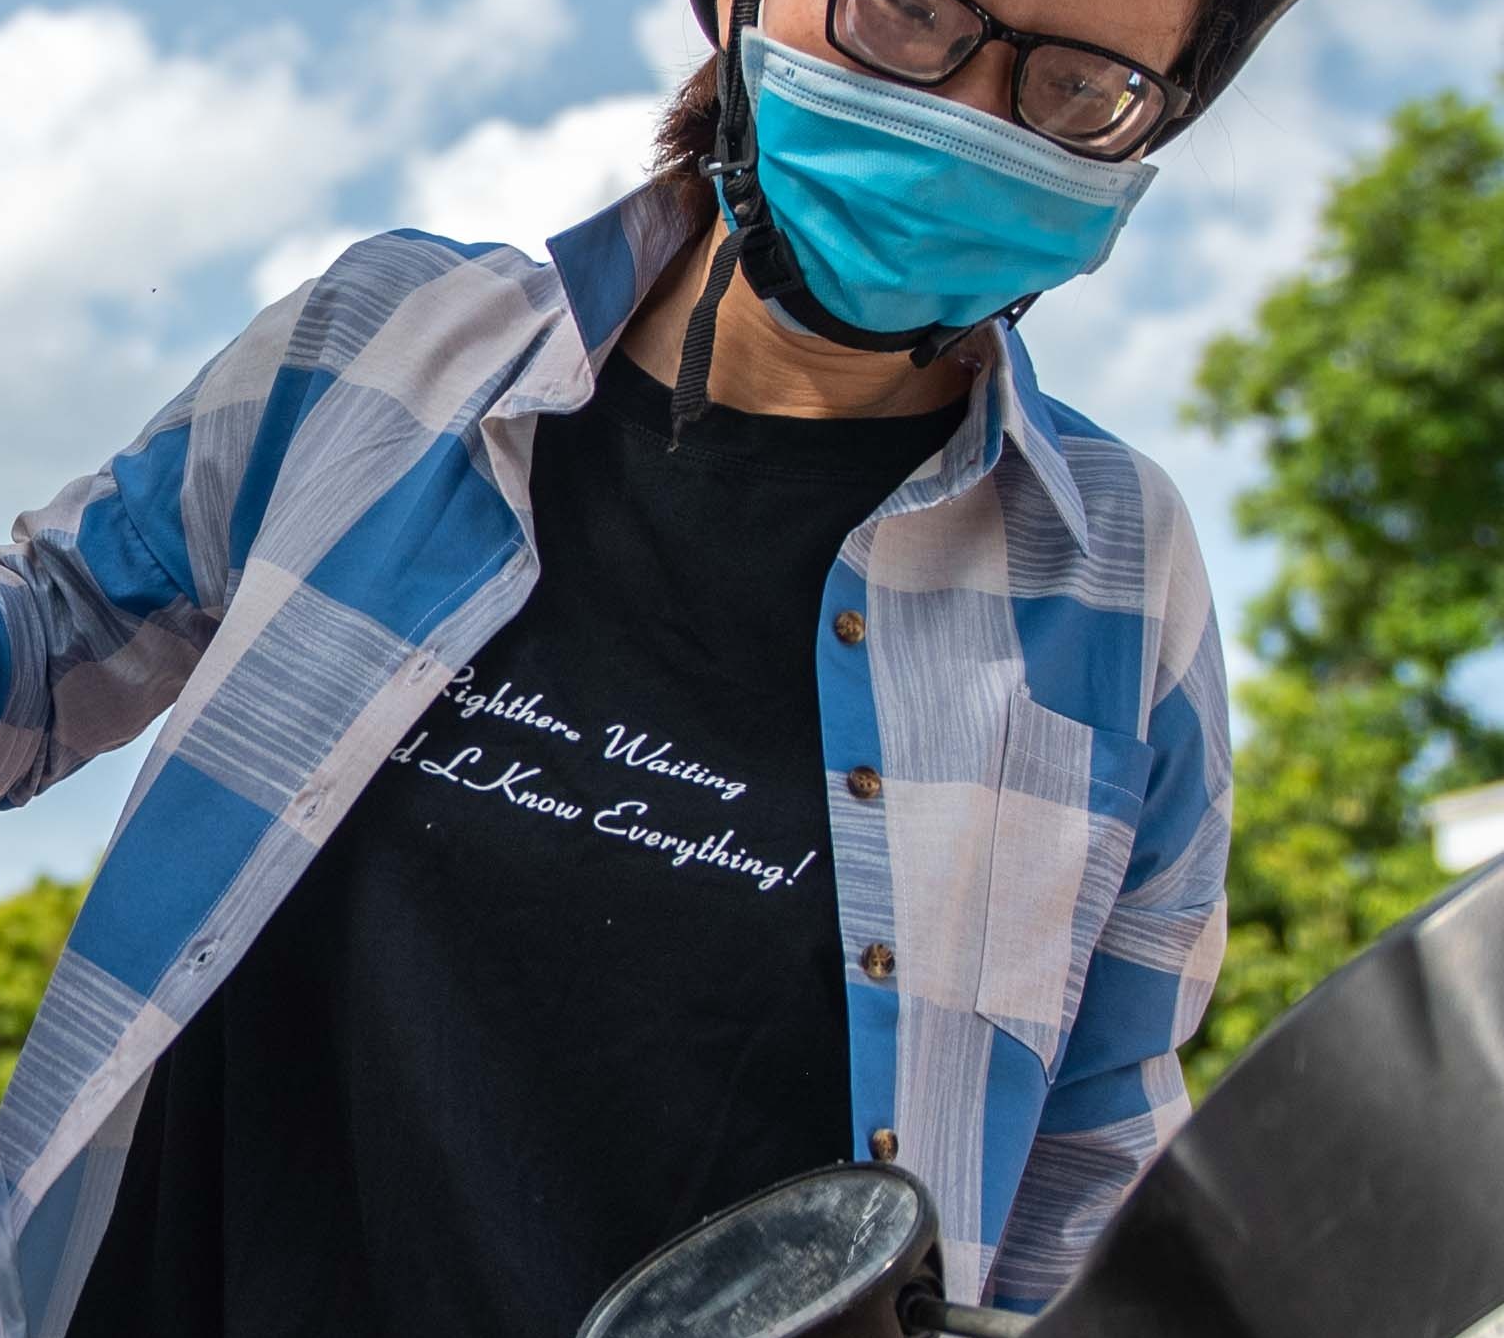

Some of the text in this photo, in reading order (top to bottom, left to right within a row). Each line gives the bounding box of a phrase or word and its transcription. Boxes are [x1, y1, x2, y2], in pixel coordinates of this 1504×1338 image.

[602, 723, 748, 801] Waiting
[463, 761, 583, 822] Know
[594, 800, 816, 890] Everything!
